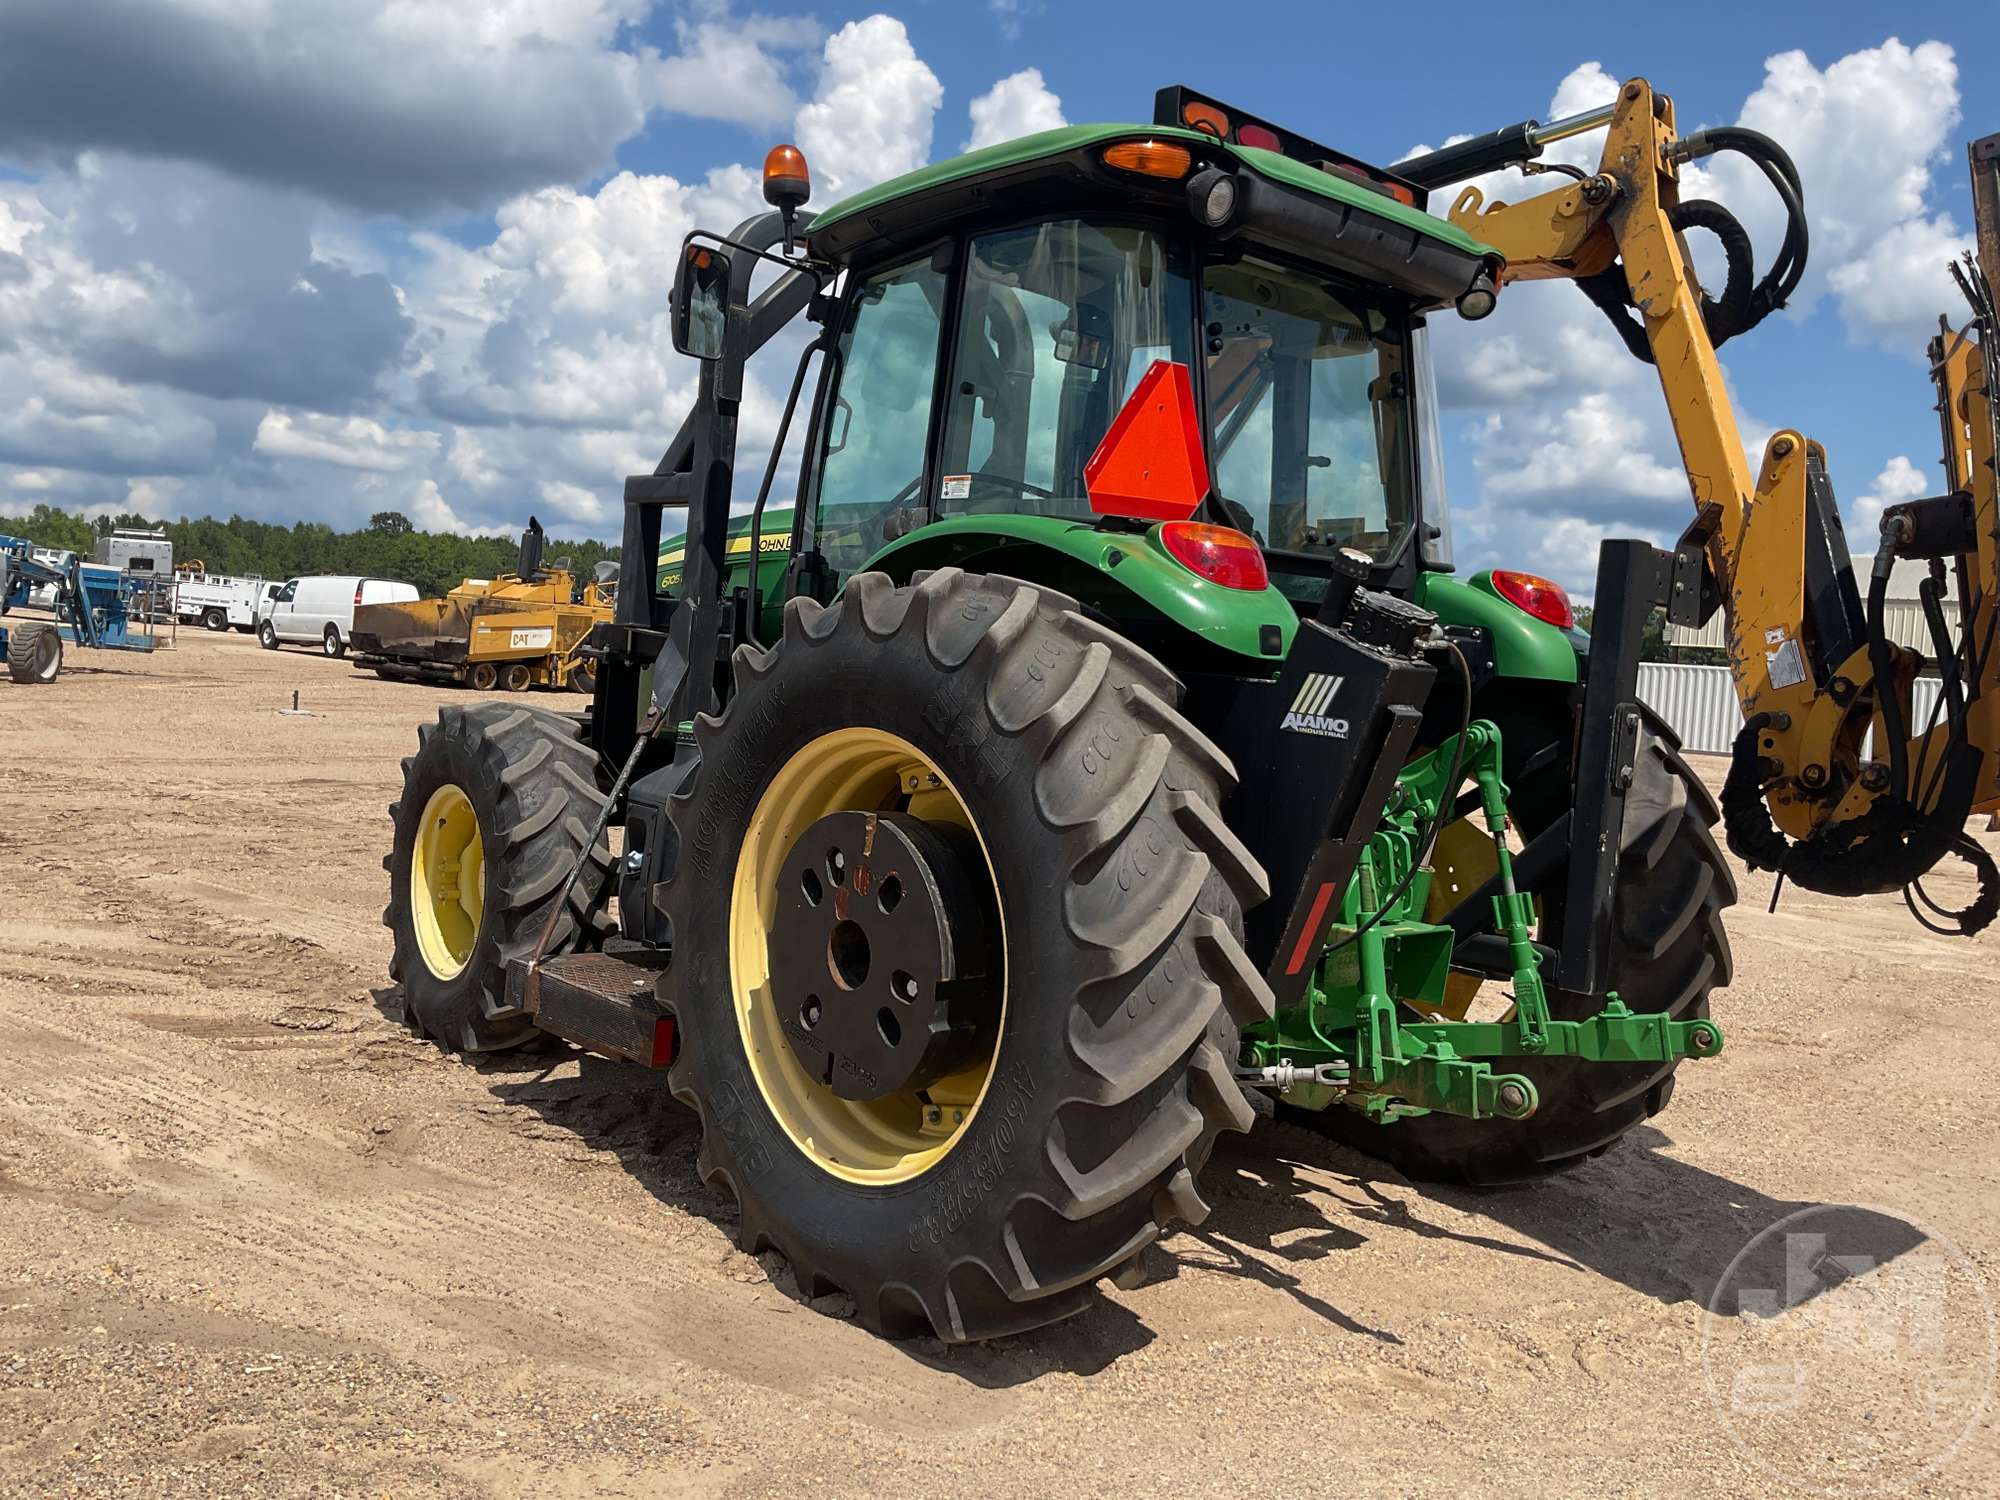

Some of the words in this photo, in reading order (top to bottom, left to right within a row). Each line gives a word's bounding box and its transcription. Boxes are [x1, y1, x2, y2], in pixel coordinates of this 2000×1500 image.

[758, 538, 785, 551] OHN
[513, 633, 529, 646] CAT
[1280, 711, 1349, 733] ALAMO
[1297, 727, 1346, 739] INDUSTRIAL
